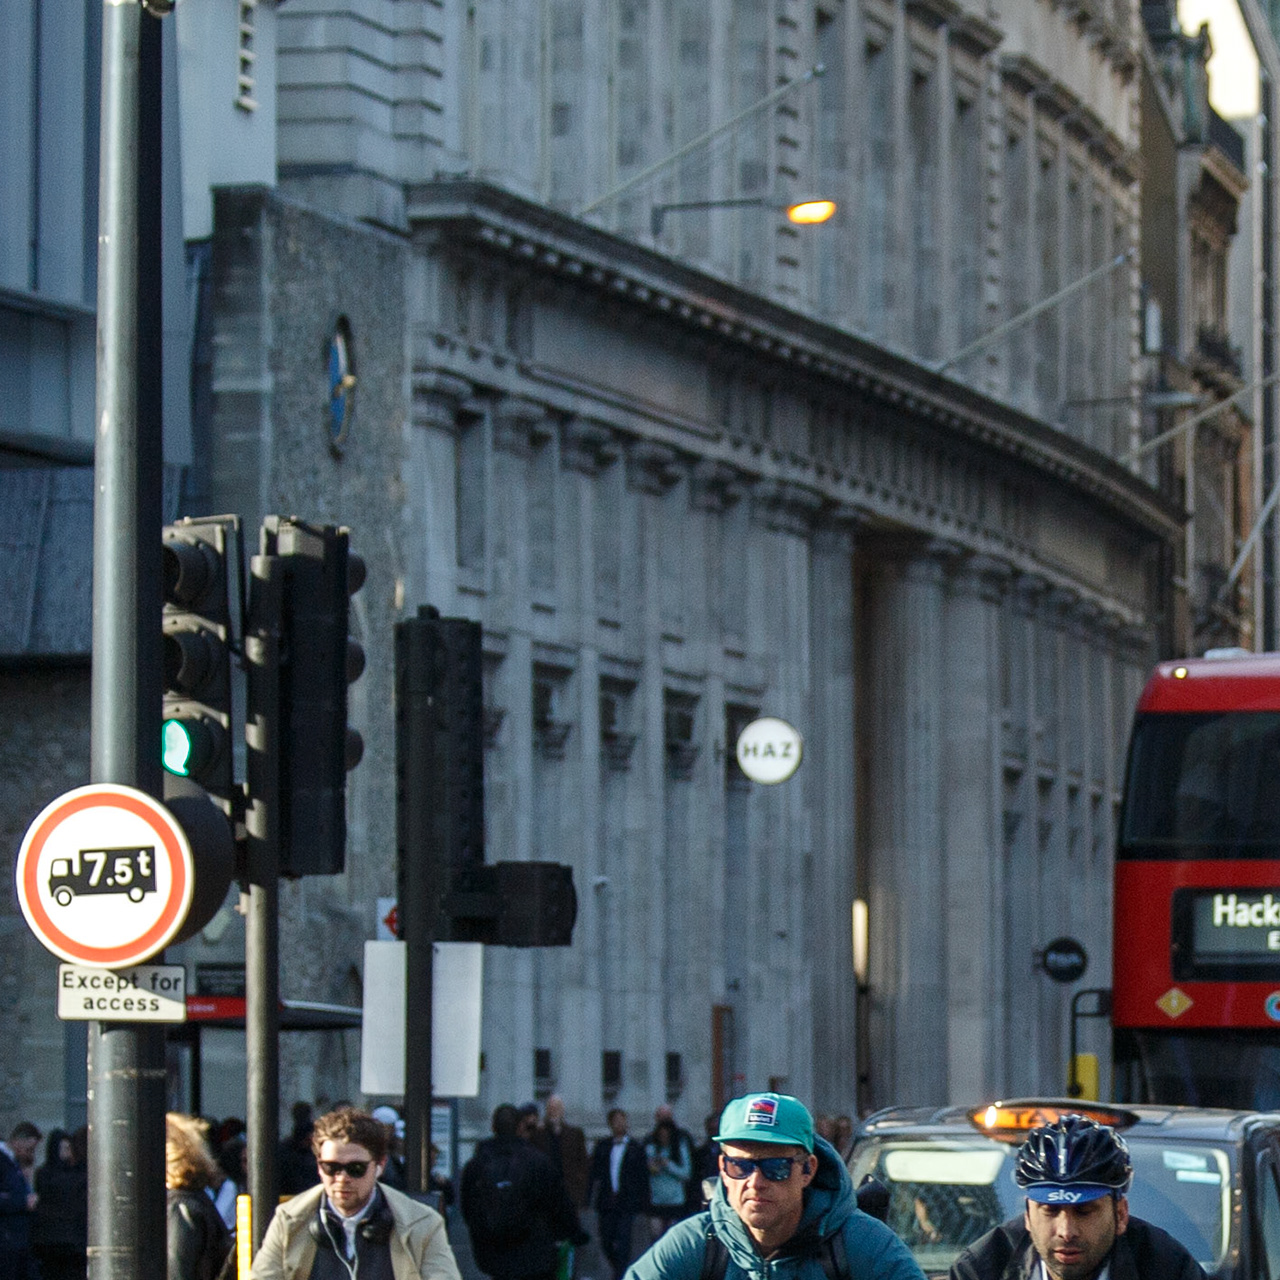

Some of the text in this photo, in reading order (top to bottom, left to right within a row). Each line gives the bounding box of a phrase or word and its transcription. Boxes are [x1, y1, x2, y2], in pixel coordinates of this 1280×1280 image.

[743, 742, 792, 757] HAZ
[62, 971, 182, 992] Except for
[83, 996, 160, 1012] access
[1048, 1189, 1082, 1203] sky
